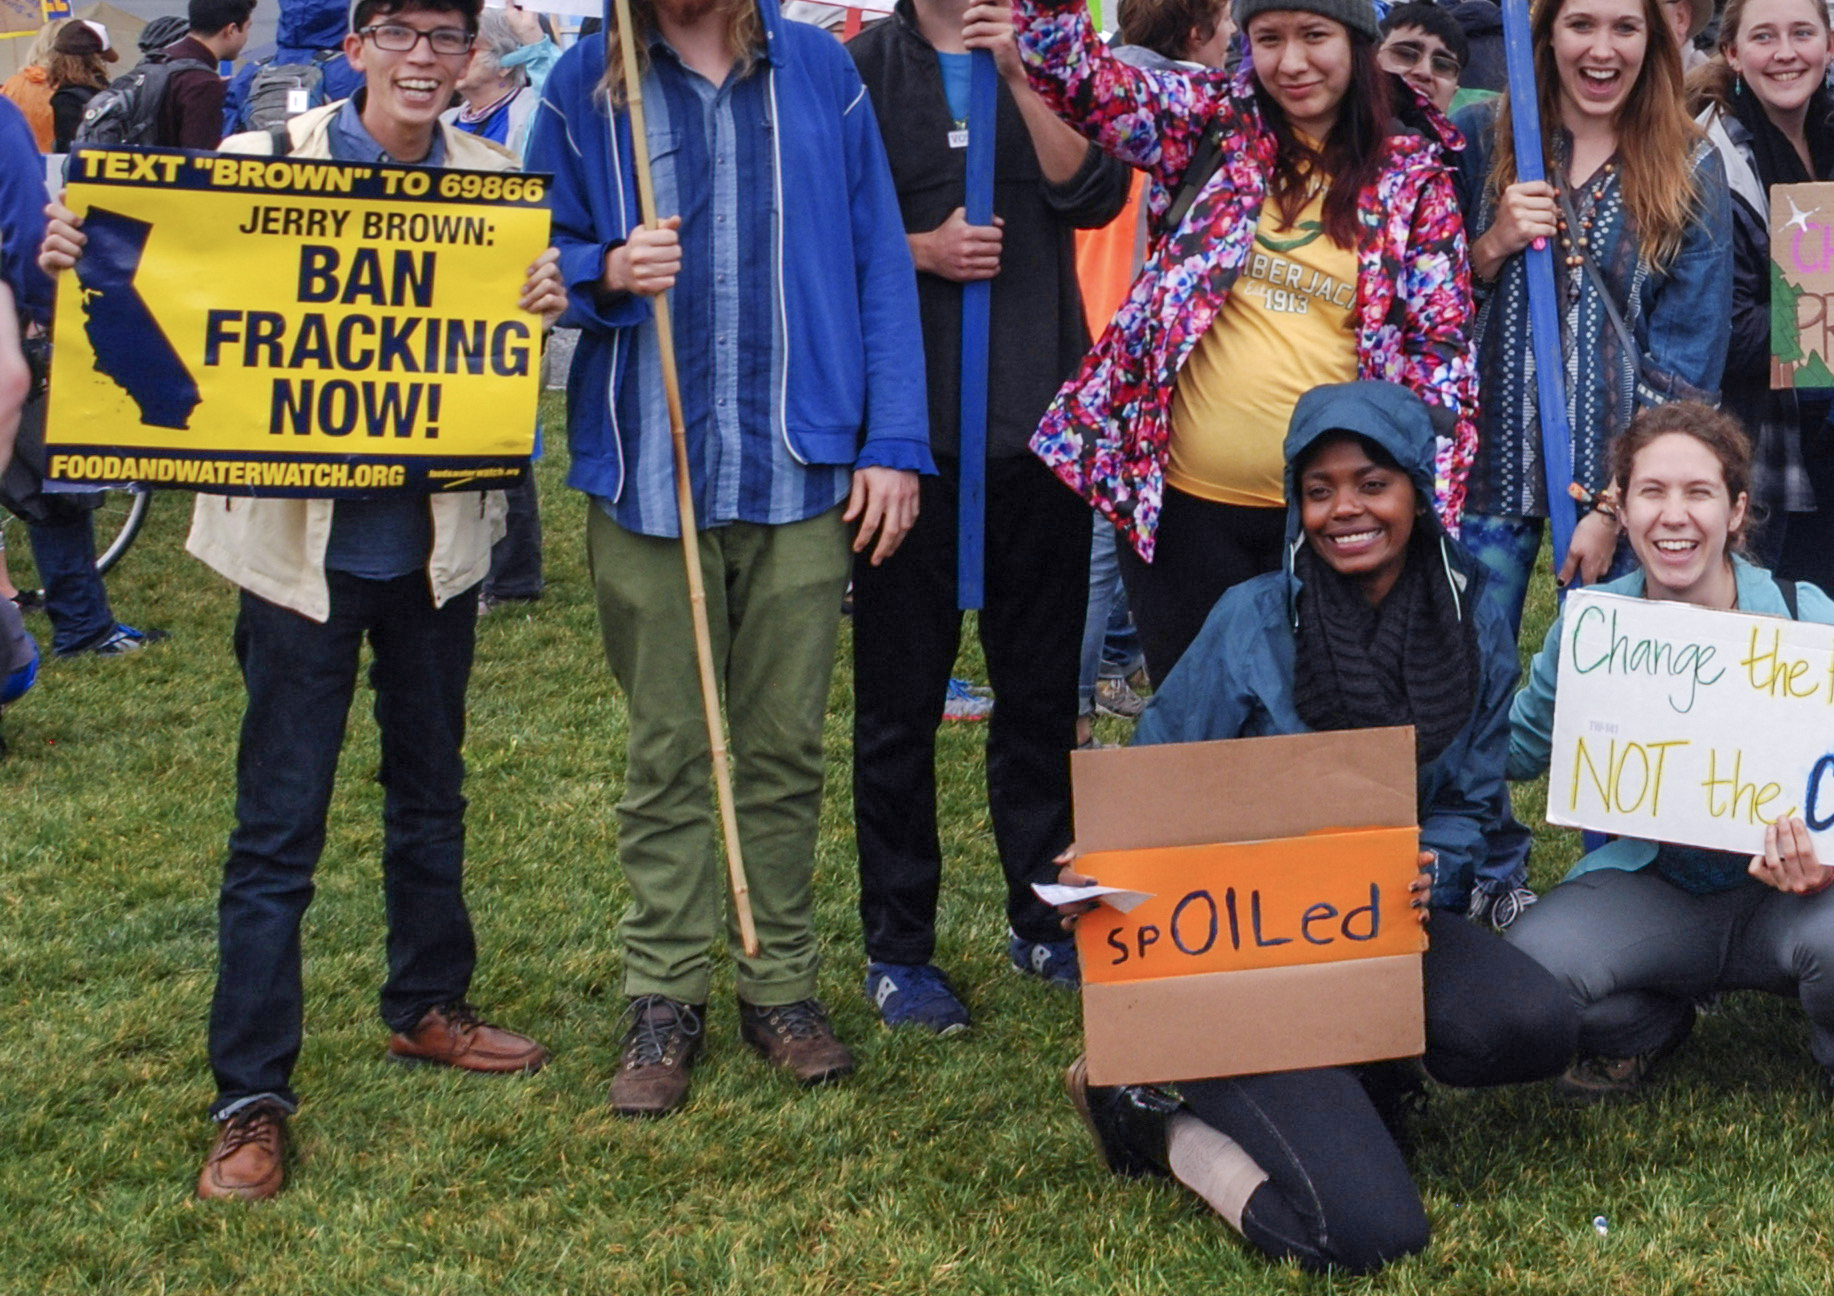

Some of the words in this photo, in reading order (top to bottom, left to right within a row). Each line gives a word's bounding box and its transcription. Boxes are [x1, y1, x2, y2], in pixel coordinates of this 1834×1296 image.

[79, 150, 185, 182] TEXT
[194, 157, 372, 193] "BROWN"
[379, 170, 430, 197] TO
[439, 173, 545, 202] 69866
[240, 205, 350, 238] JERRY
[362, 212, 495, 247] BROWN:
[297, 244, 437, 308] BAN
[1264, 288, 1309, 314] 1913
[204, 309, 531, 377] FRACKING
[269, 378, 442, 439] NOW!
[50, 454, 405, 487] FOODANDWATERWATCH.ORG
[1572, 606, 1726, 714] Change
[1741, 625, 1819, 698] the
[1571, 736, 1691, 818] NOT
[1701, 748, 1797, 825] the
